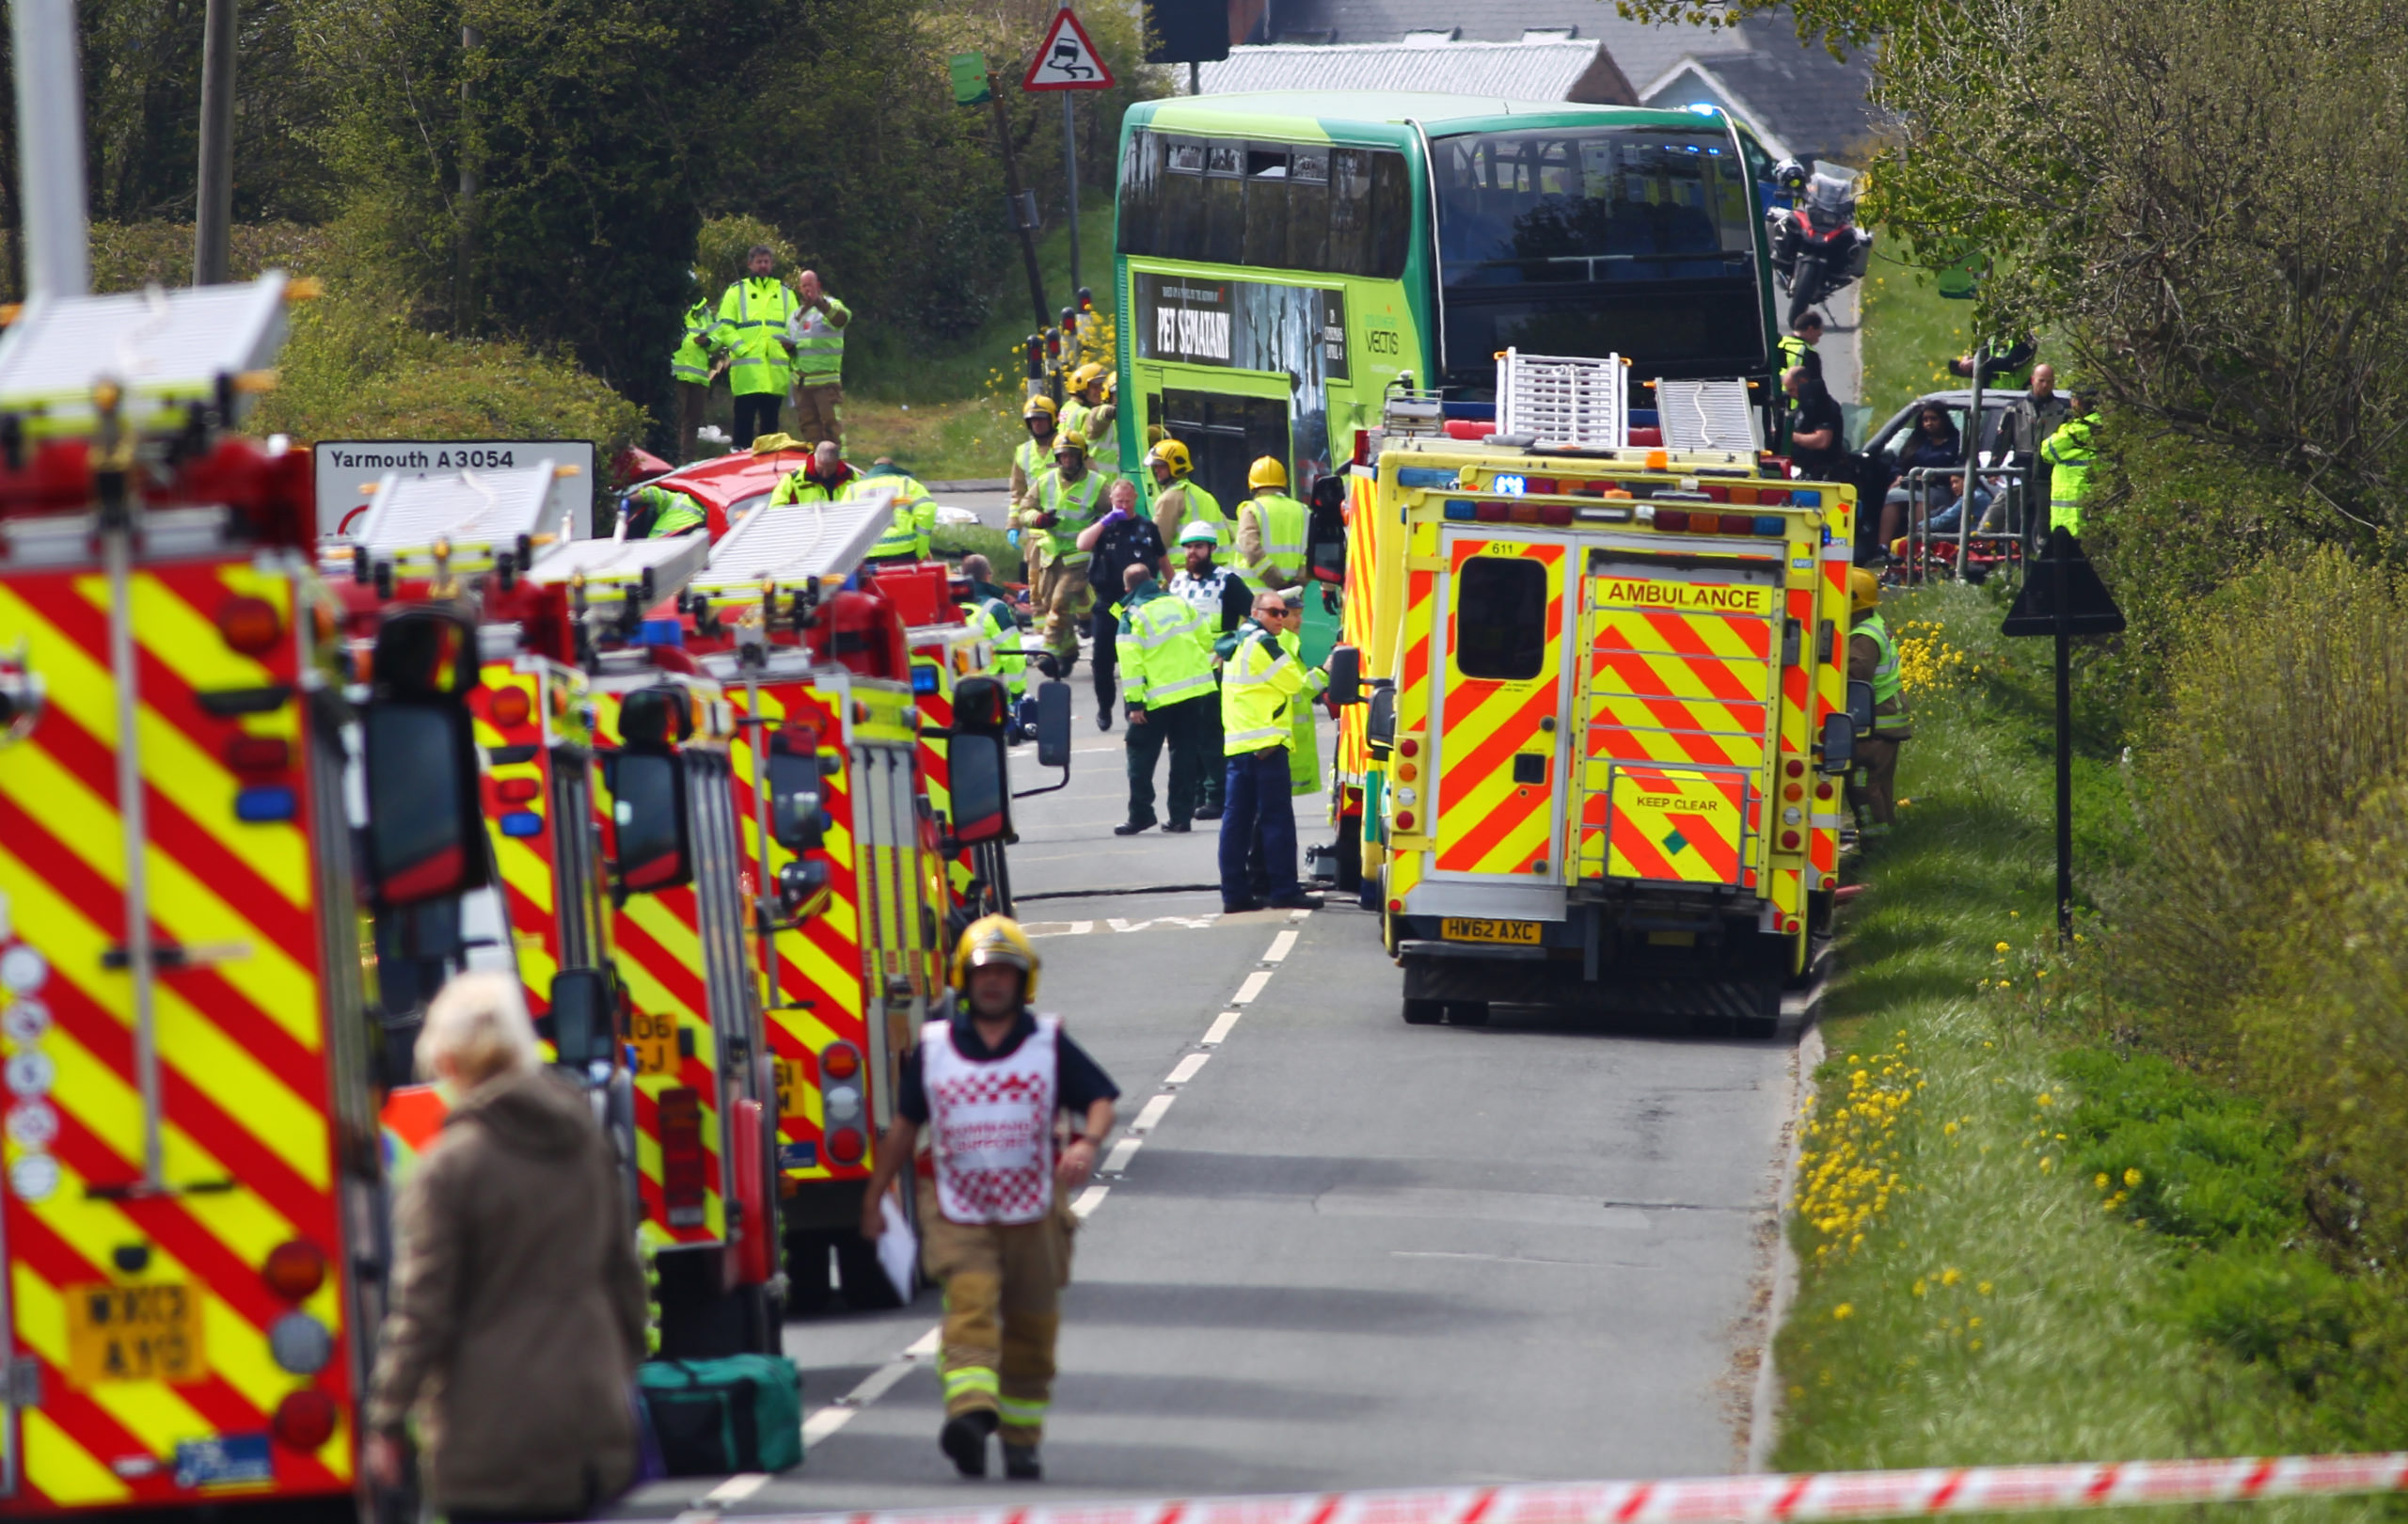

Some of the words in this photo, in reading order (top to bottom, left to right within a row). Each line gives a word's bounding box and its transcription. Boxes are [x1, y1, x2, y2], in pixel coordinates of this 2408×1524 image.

[1157, 307, 1176, 353] PET
[1178, 309, 1229, 359] SEMATARY
[1365, 330, 1399, 355] VECTIS
[331, 451, 428, 468] Yarmouth
[1492, 543, 1513, 554] 611
[1608, 582, 1761, 609] AMBULANCE
[1637, 796, 1671, 807] KEEP
[1674, 799, 1718, 811] CLEAR
[1449, 919, 1495, 938] HW62
[1498, 921, 1533, 940] AXC
